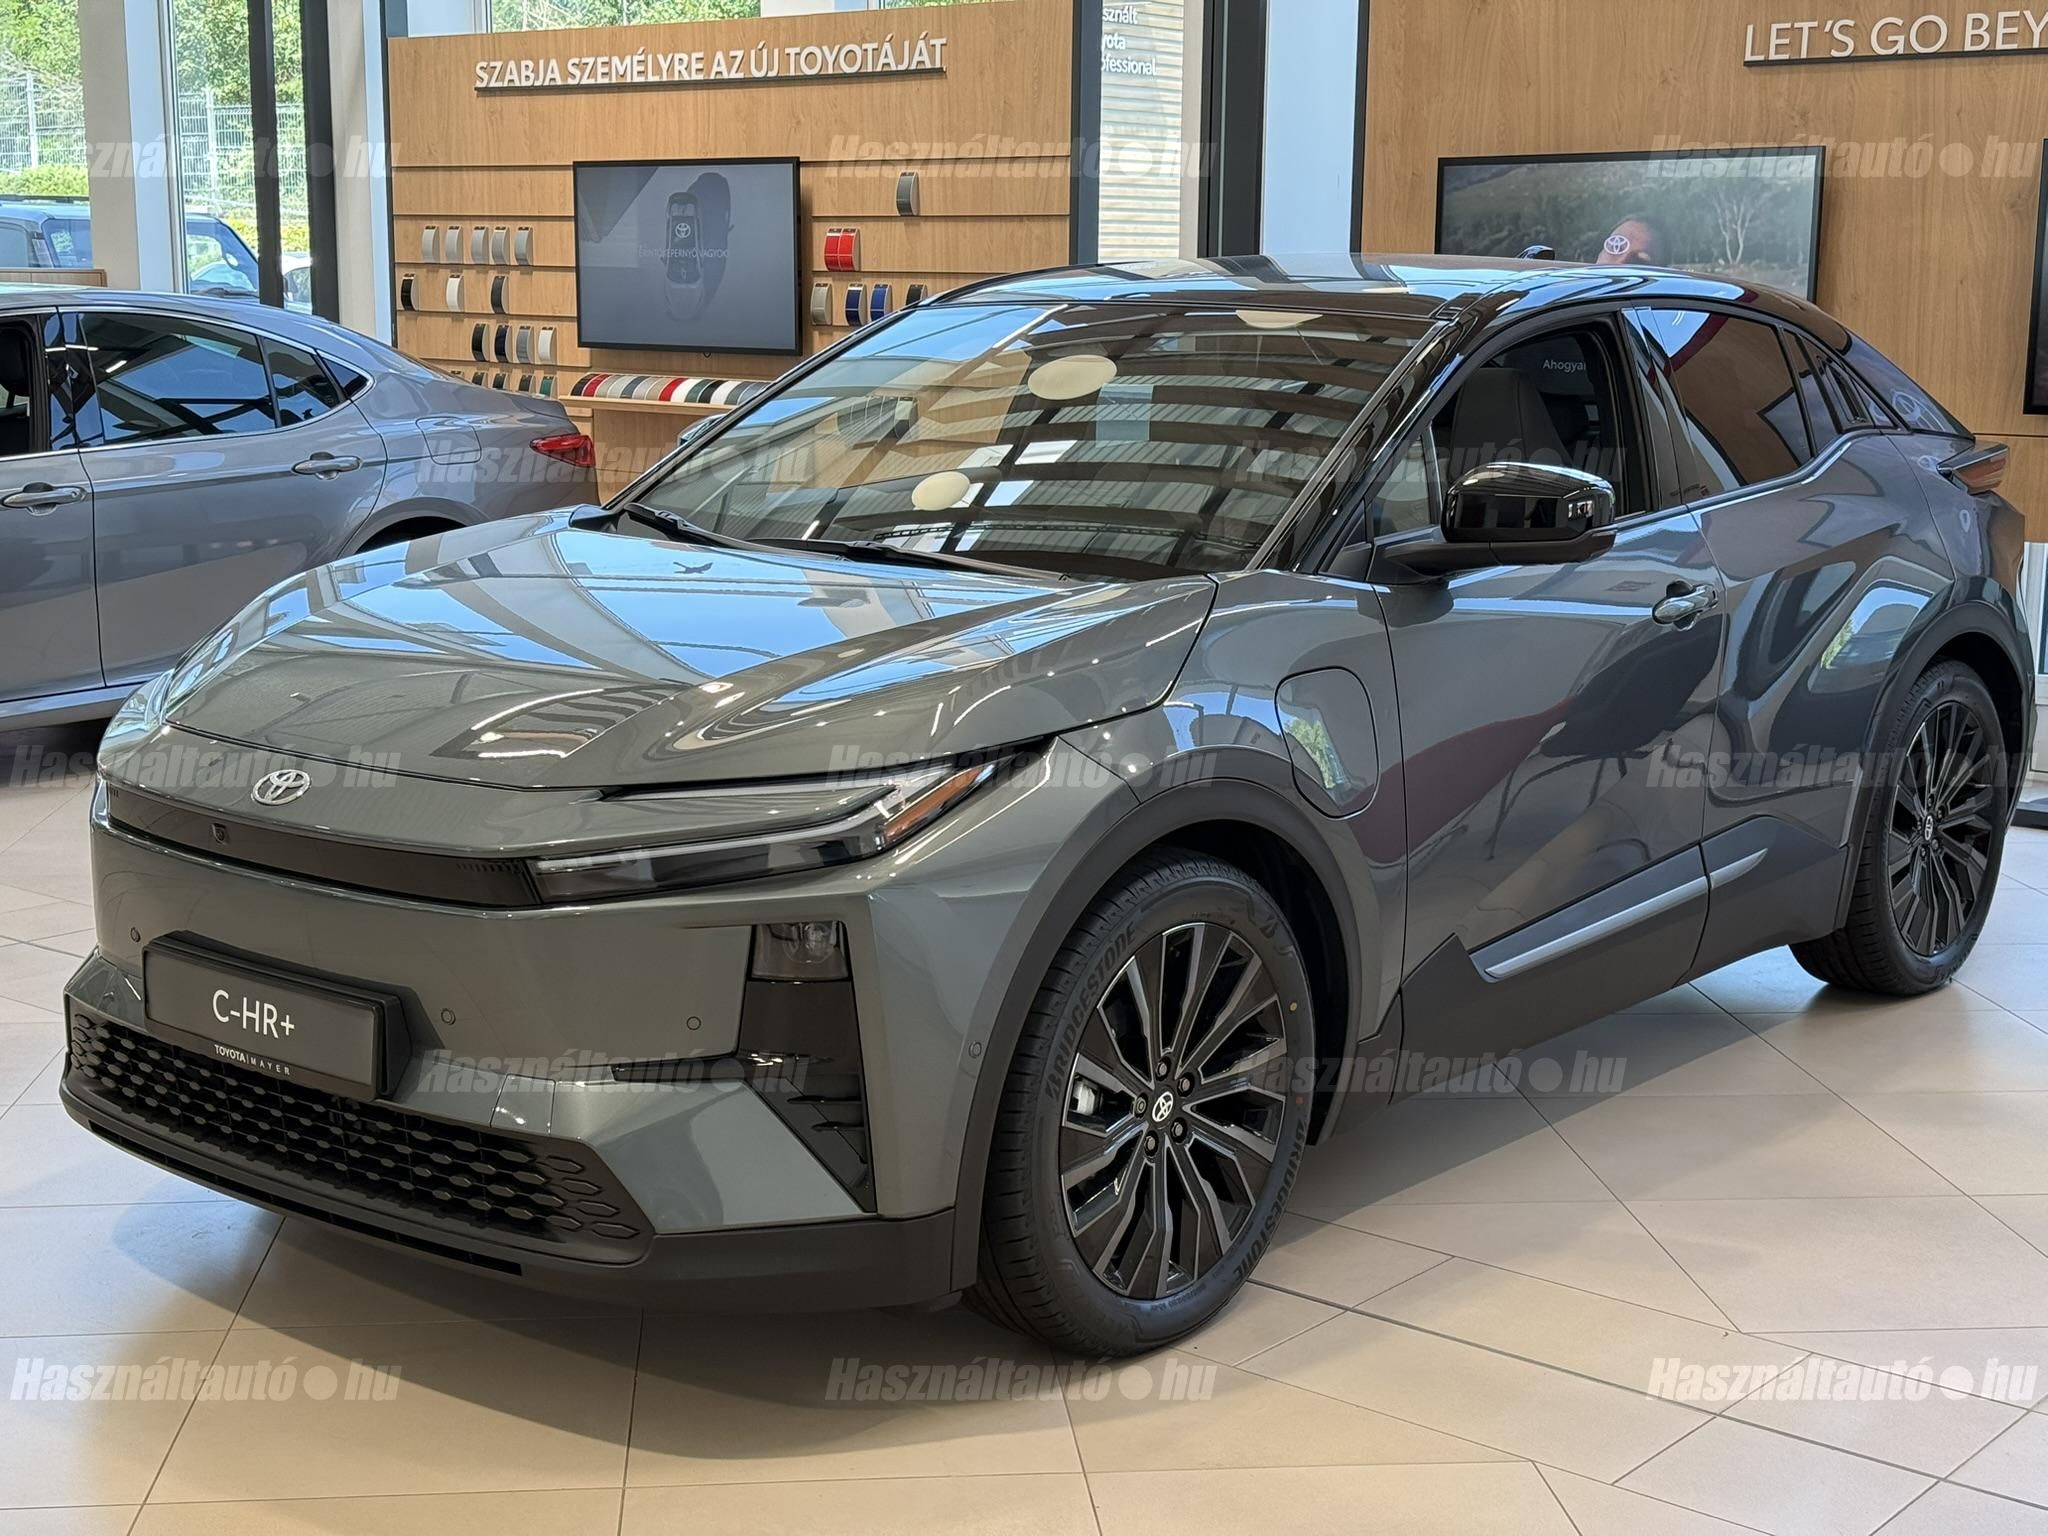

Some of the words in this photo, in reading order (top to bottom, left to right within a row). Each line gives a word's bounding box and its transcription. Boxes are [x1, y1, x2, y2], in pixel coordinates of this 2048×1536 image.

[475, 59, 562, 88] SZABJA
[566, 47, 705, 84] SZEMÉLYRE
[709, 50, 745, 79] AZ
[750, 40, 780, 78] ÚJ
[785, 31, 947, 75] TOYOTÁJÁT
[1744, 19, 1856, 61] LET'S
[1870, 15, 1949, 55] GO
[1963, 10, 2048, 51] BEY
[212, 989, 295, 1038] C-HR+
[1044, 920, 1137, 1102] BRIDGESTONE
